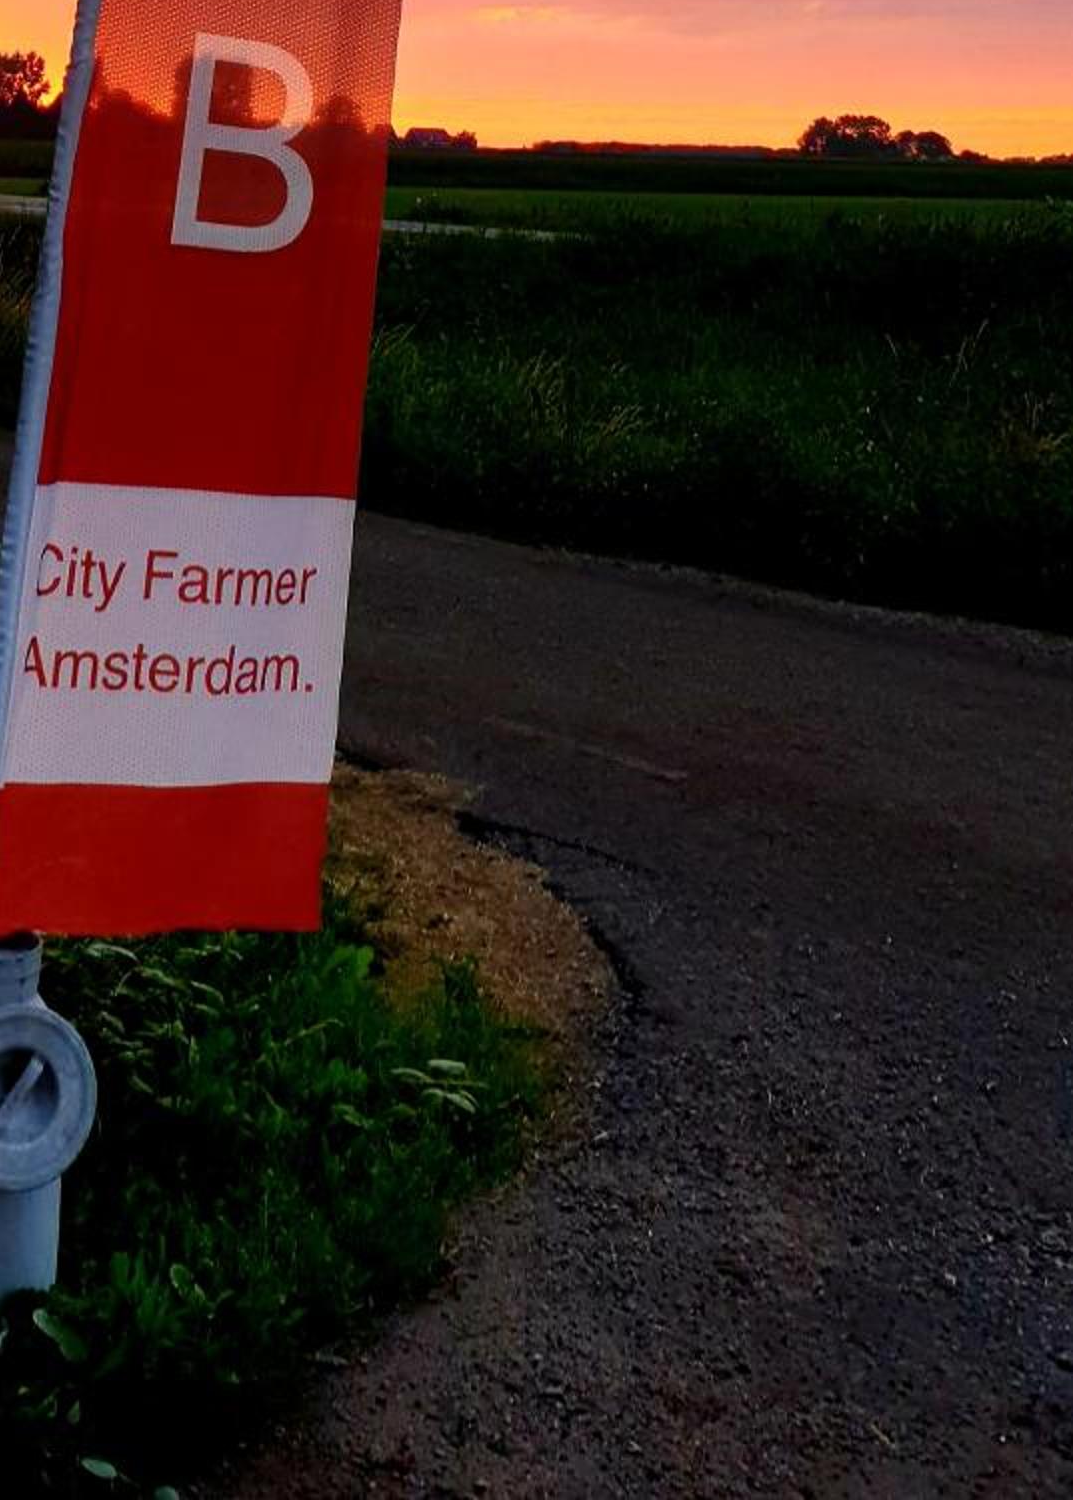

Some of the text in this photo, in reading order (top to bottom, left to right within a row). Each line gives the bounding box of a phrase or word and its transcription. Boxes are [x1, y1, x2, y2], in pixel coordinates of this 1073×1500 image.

[171, 33, 314, 253] B
[36, 543, 317, 612] City Farmer
[24, 636, 314, 696] Amsterdam.
